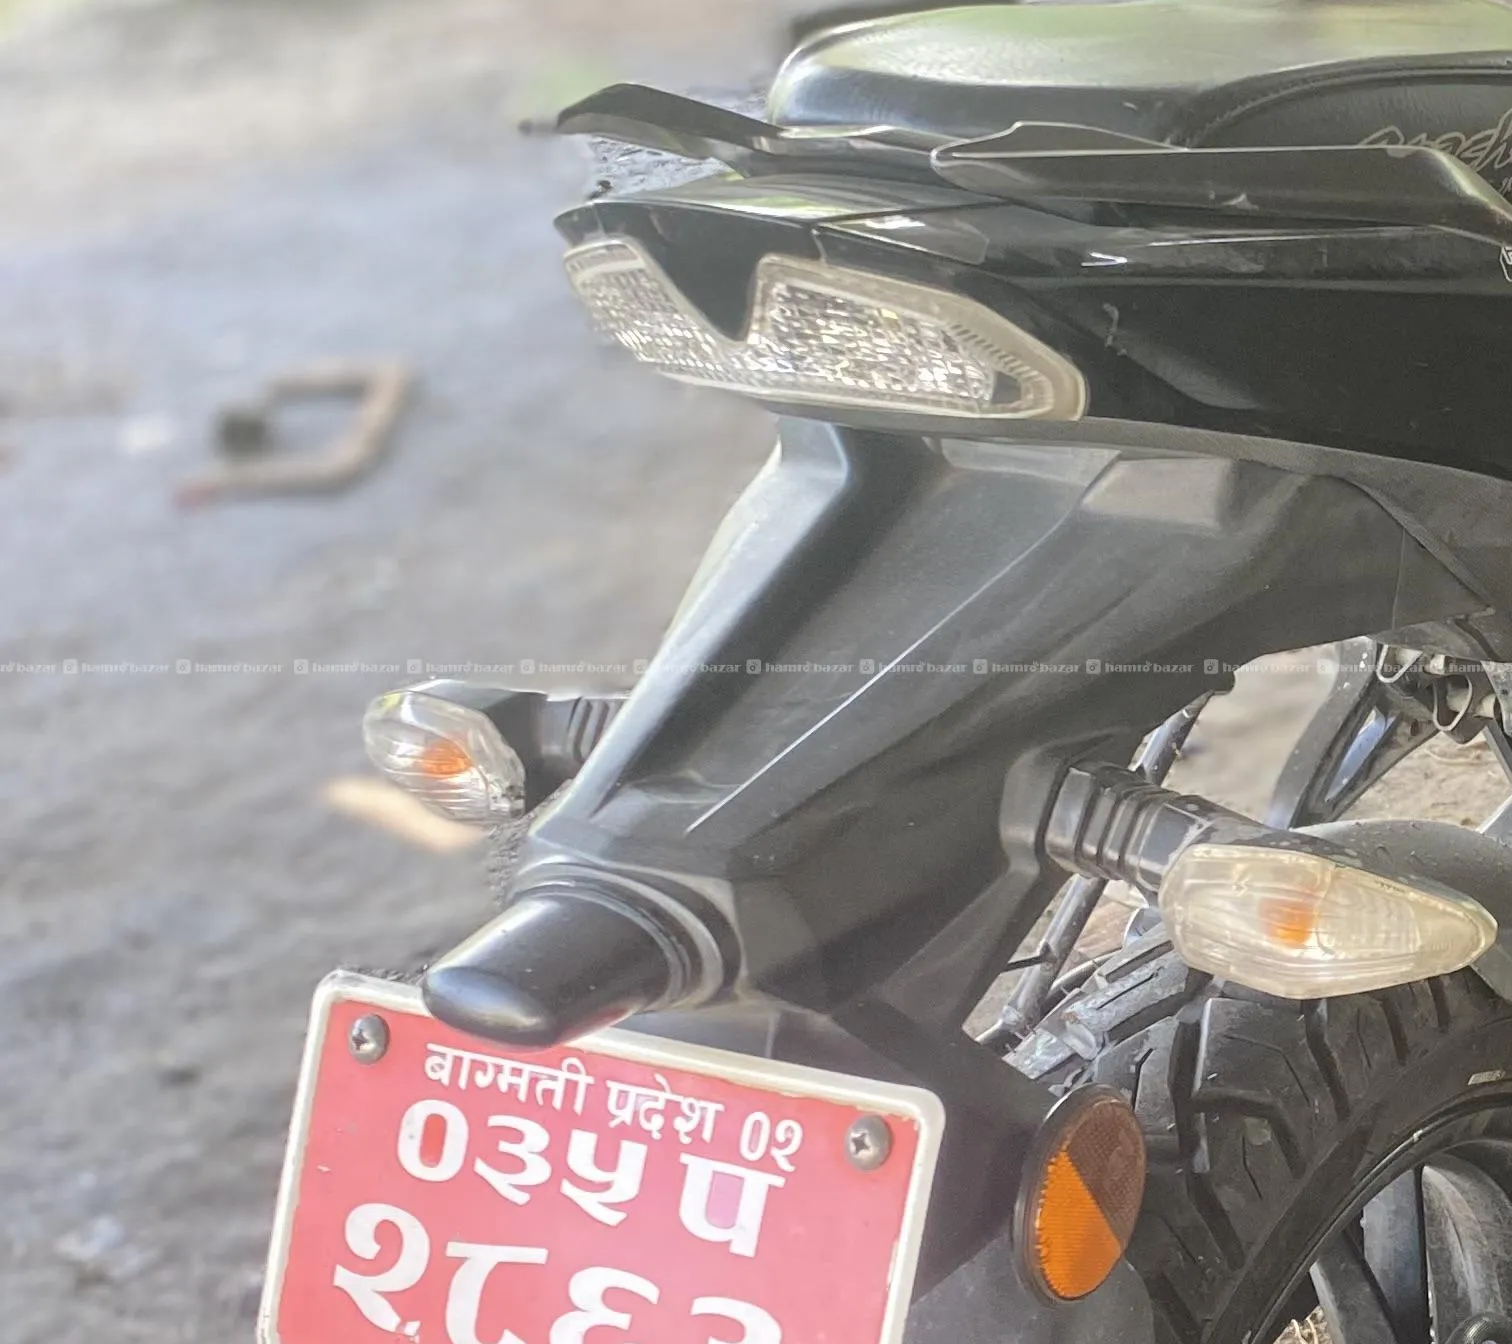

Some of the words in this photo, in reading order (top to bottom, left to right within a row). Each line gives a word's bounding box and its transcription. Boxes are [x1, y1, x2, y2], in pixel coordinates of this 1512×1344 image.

[425, 1042, 595, 1116] बाग्मती
[605, 1073, 725, 1145] प्रदेश
[678, 1152, 786, 1258] प
